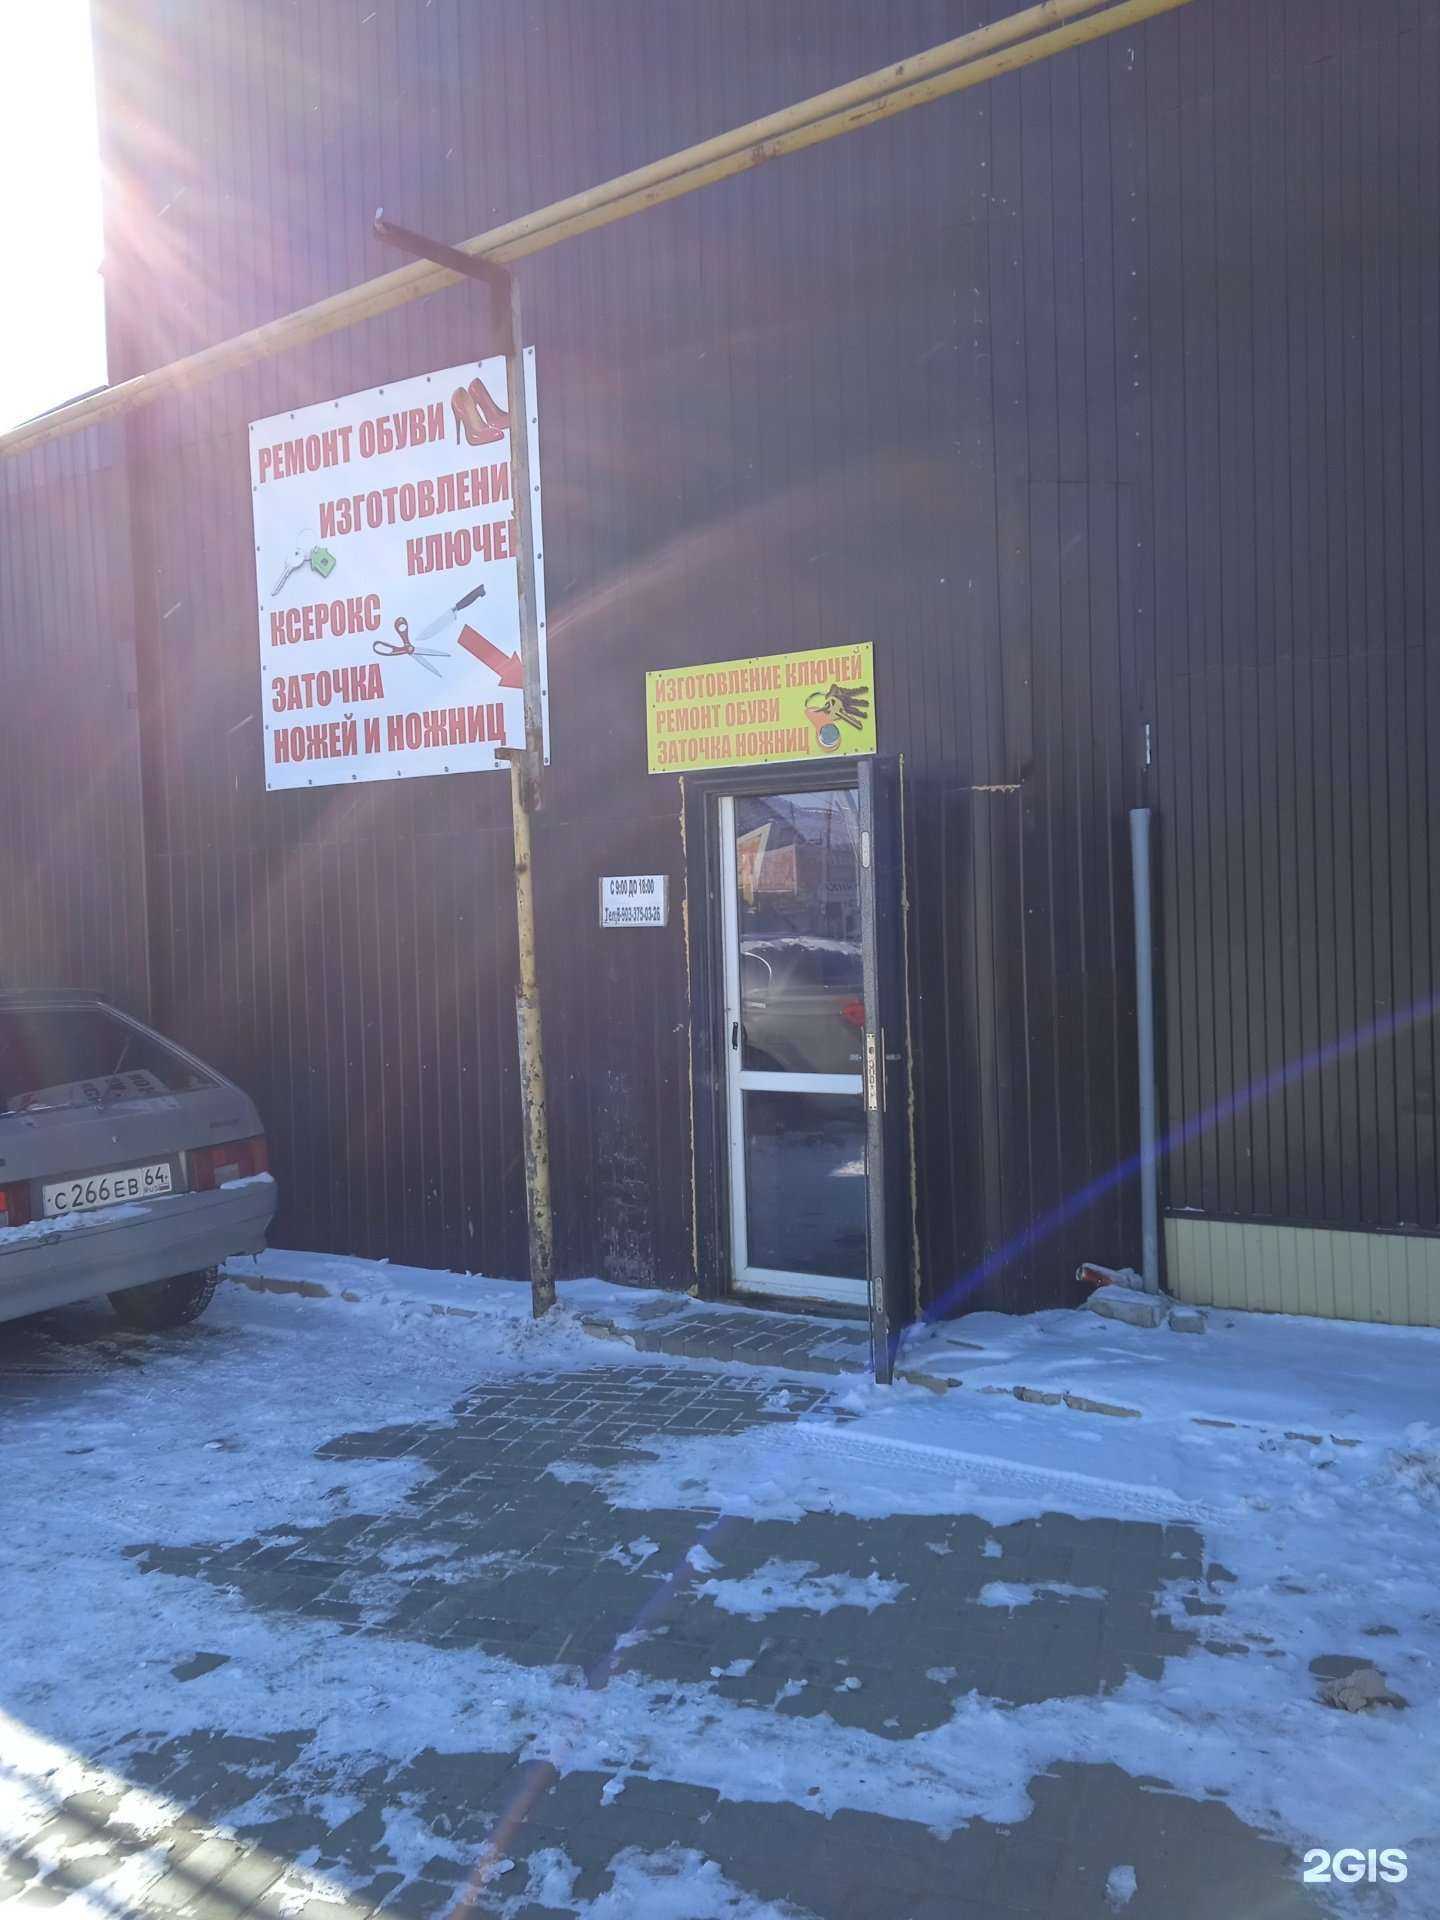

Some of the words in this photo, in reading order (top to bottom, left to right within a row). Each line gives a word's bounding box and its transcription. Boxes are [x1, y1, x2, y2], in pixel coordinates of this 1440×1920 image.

[258, 425, 353, 483] РЕМОНТ
[359, 401, 445, 459] ОБУВИ
[319, 462, 510, 539] ИЗГОТОВЛЕНИ
[270, 593, 382, 647] КСЕРОКС
[271, 663, 385, 713] ЗАТОЧКА
[655, 664, 781, 703] ИЗГОТОВЛЕНИЕ
[785, 645, 862, 688] КЛЮЧЕЙ
[274, 712, 358, 764] НОЖЕЙ
[364, 716, 381, 754] И
[387, 702, 507, 752] НОЖНИЦ
[656, 703, 721, 734] РЕМОНТ
[725, 697, 780, 727] ОБУВИ
[656, 734, 732, 764] ЗАТОЧКА
[735, 727, 810, 757] НОЖНИЦ
[610, 880, 615, 895] С
[629, 879, 638, 898] ДО
[145, 1167, 164, 1185] 64
